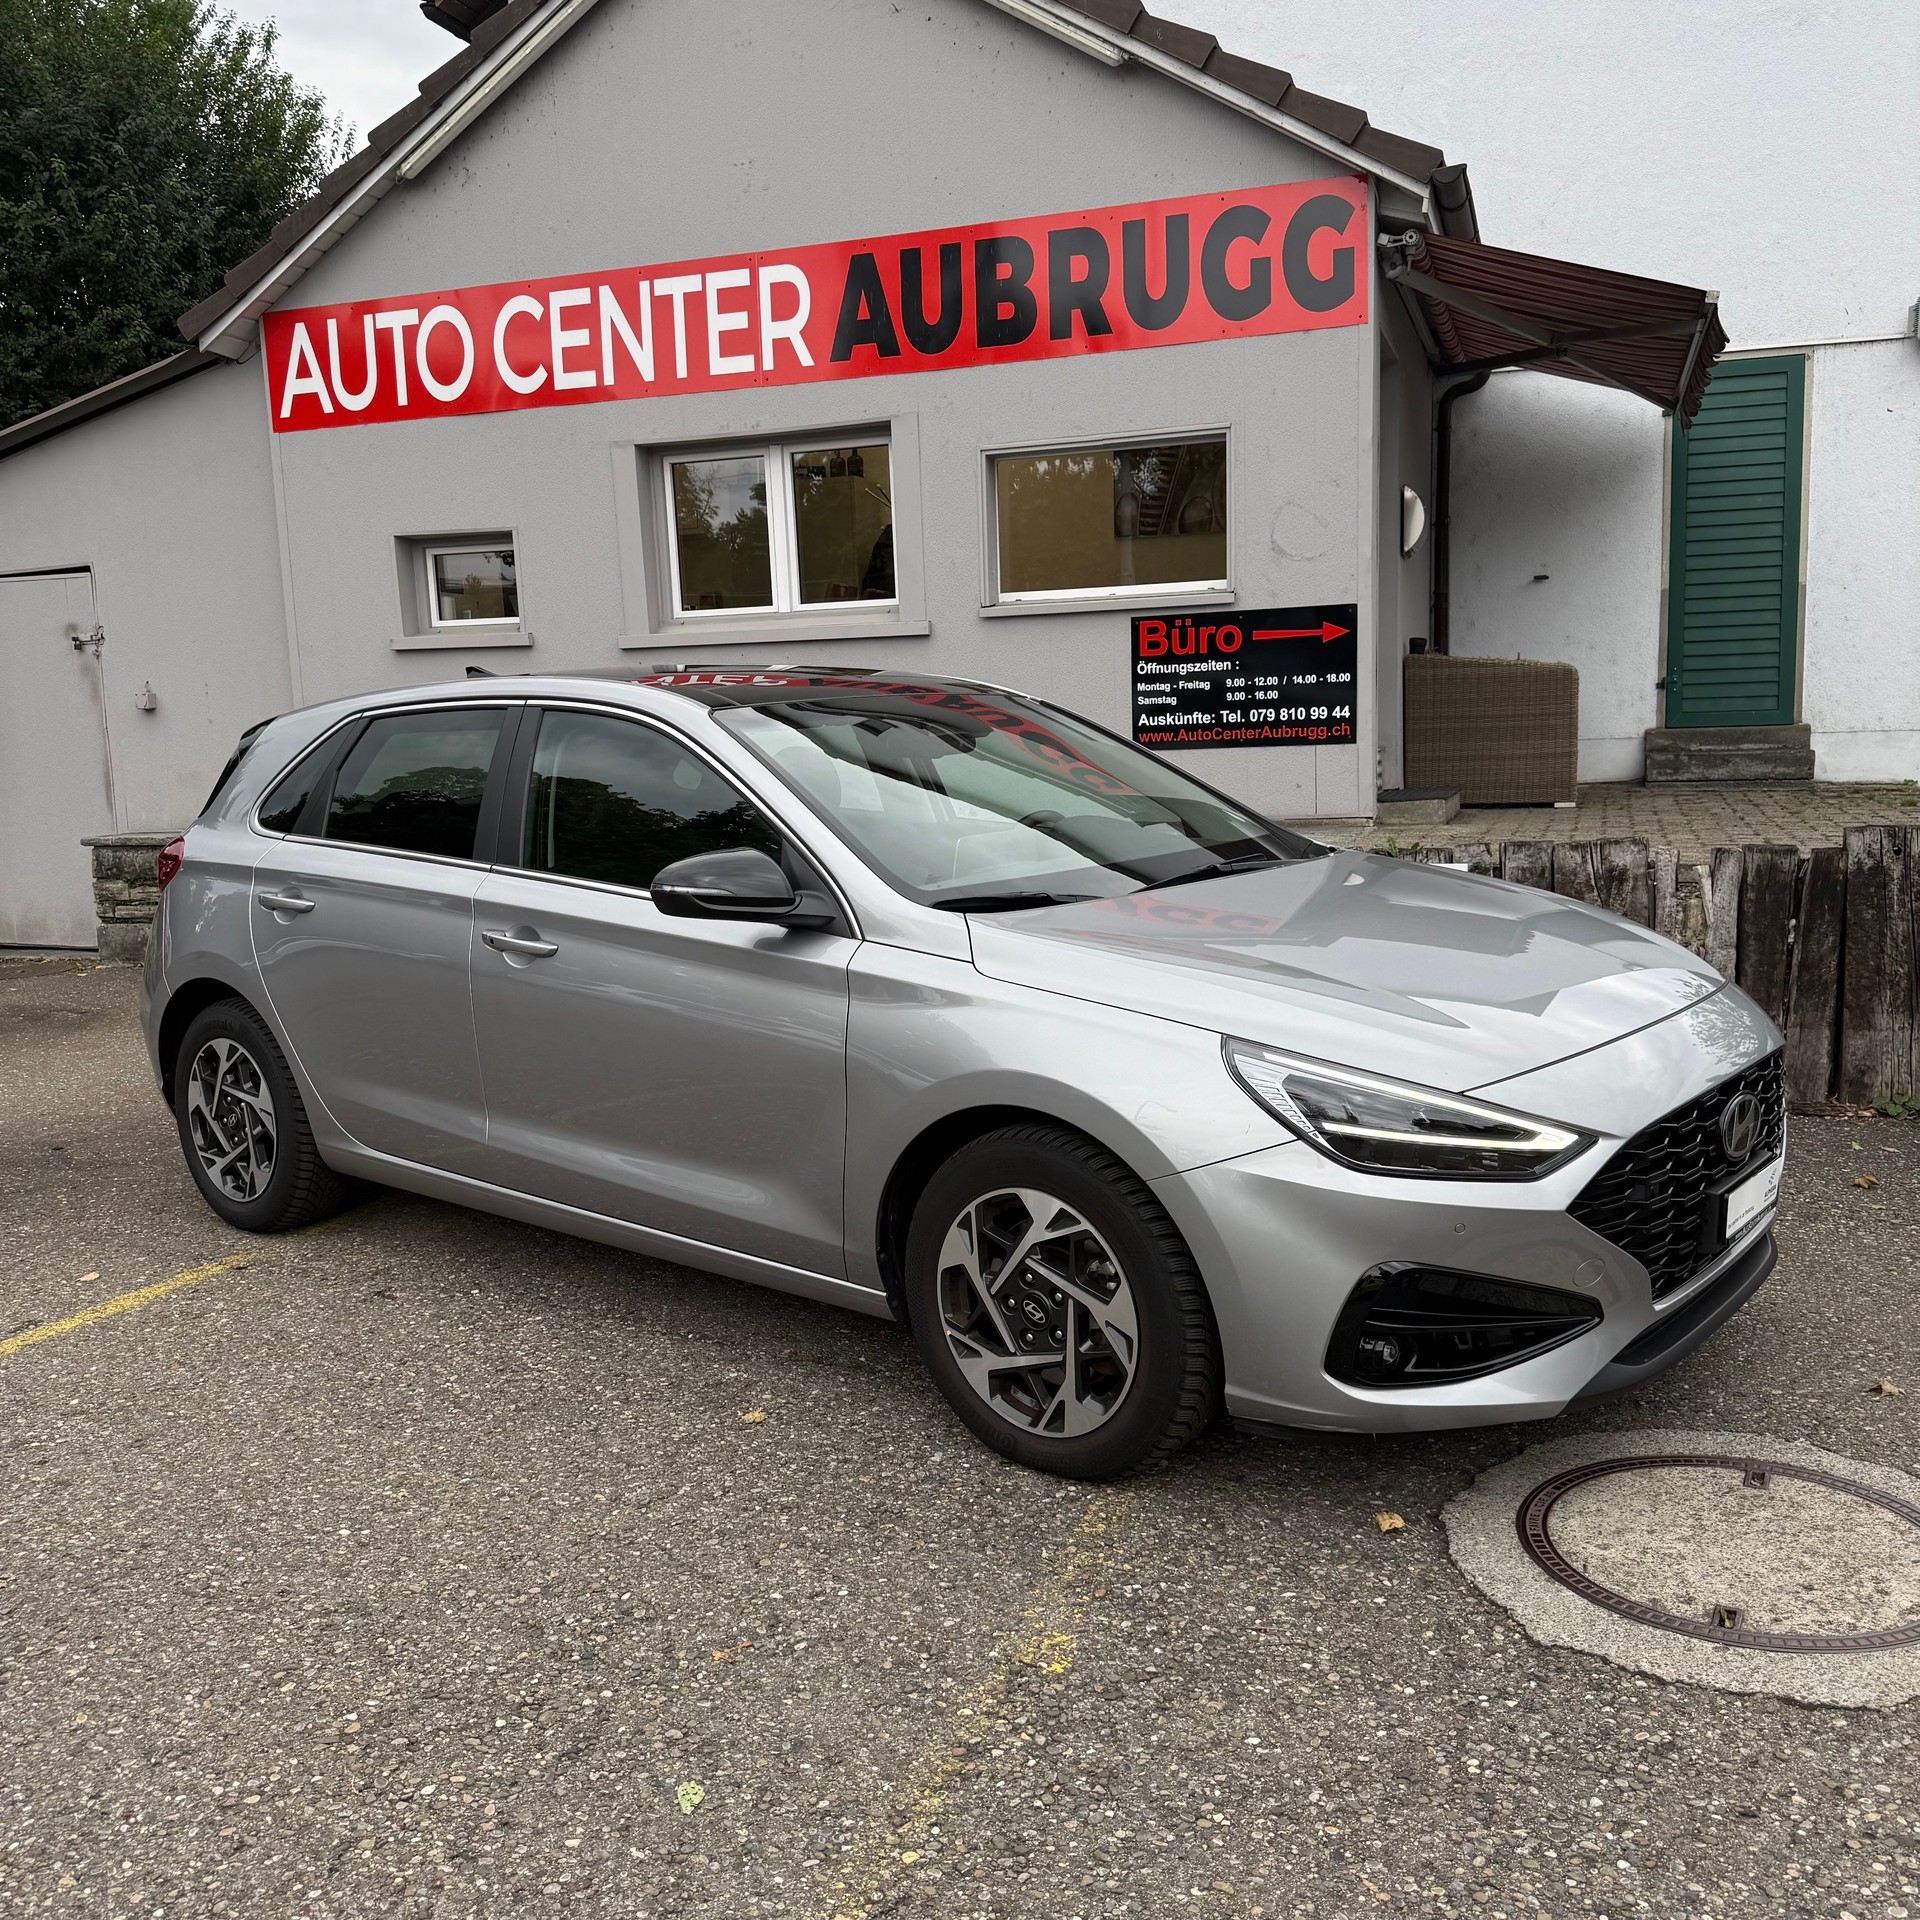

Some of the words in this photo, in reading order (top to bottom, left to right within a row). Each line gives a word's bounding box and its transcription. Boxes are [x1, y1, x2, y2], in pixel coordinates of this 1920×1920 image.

[279, 303, 475, 419] AUTO
[492, 263, 816, 395] CENTER
[829, 194, 1356, 363] AUBRUGG
[1139, 618, 1243, 657] Büro
[1136, 660, 1232, 675] Öffnungszeiten
[1137, 682, 1171, 692] Montag
[1178, 680, 1211, 690] Freitag
[1226, 677, 1245, 687] 9.00
[1253, 676, 1279, 686] 12.00
[1283, 675, 1287, 685] /
[1292, 674, 1317, 684] 14.00
[1325, 672, 1351, 683] 18.00
[1137, 695, 1177, 705] Samstag
[1226, 691, 1246, 701] 9.00
[1254, 690, 1279, 700] 16.00
[1138, 712, 1216, 727] Auskünfte:
[1220, 709, 1245, 723] Tel.
[1249, 708, 1276, 722] 079
[1280, 707, 1306, 721] 810
[1310, 706, 1328, 720] 99
[1331, 705, 1351, 719] 44
[1138, 722, 1351, 742] www.AutoCenterAubrugg.ch
